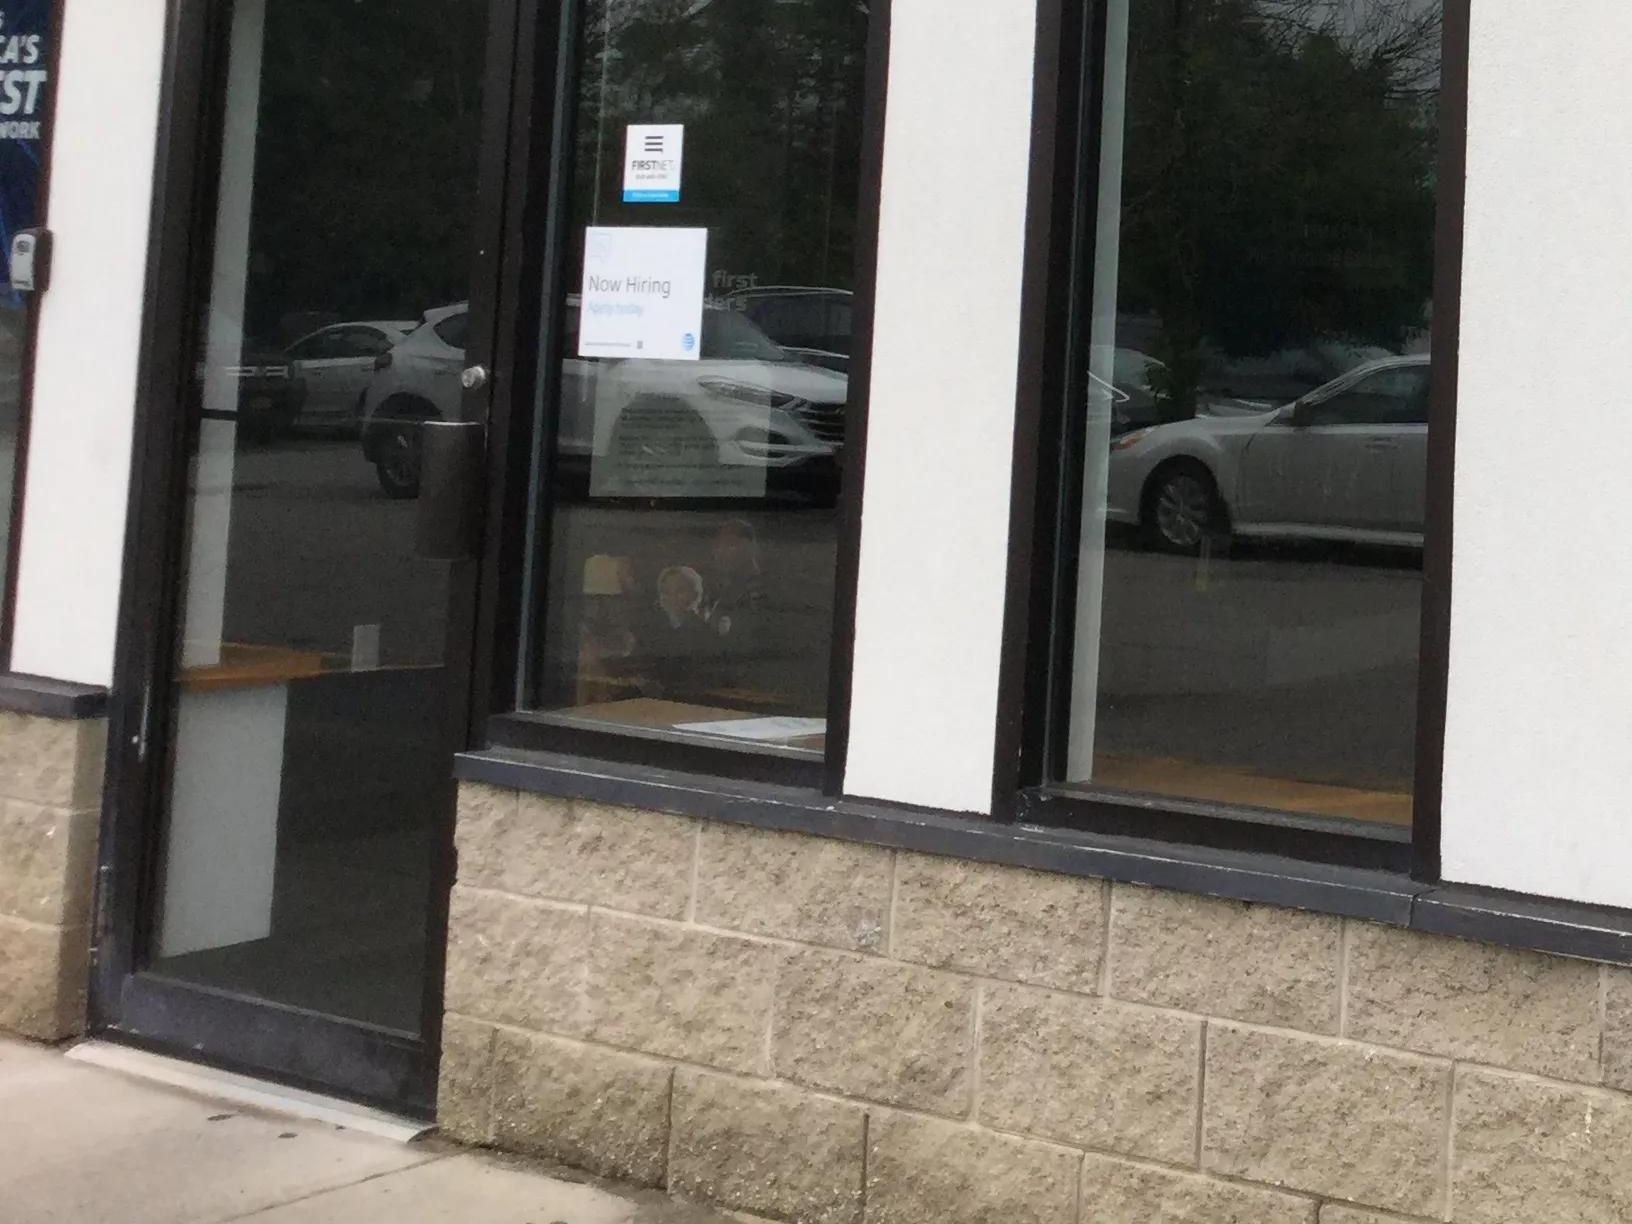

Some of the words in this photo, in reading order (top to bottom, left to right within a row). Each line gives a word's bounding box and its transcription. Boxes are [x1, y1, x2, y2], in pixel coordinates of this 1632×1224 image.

[0, 69, 47, 115] ST
[588, 275, 621, 292] Now
[626, 276, 671, 298] Hiring
